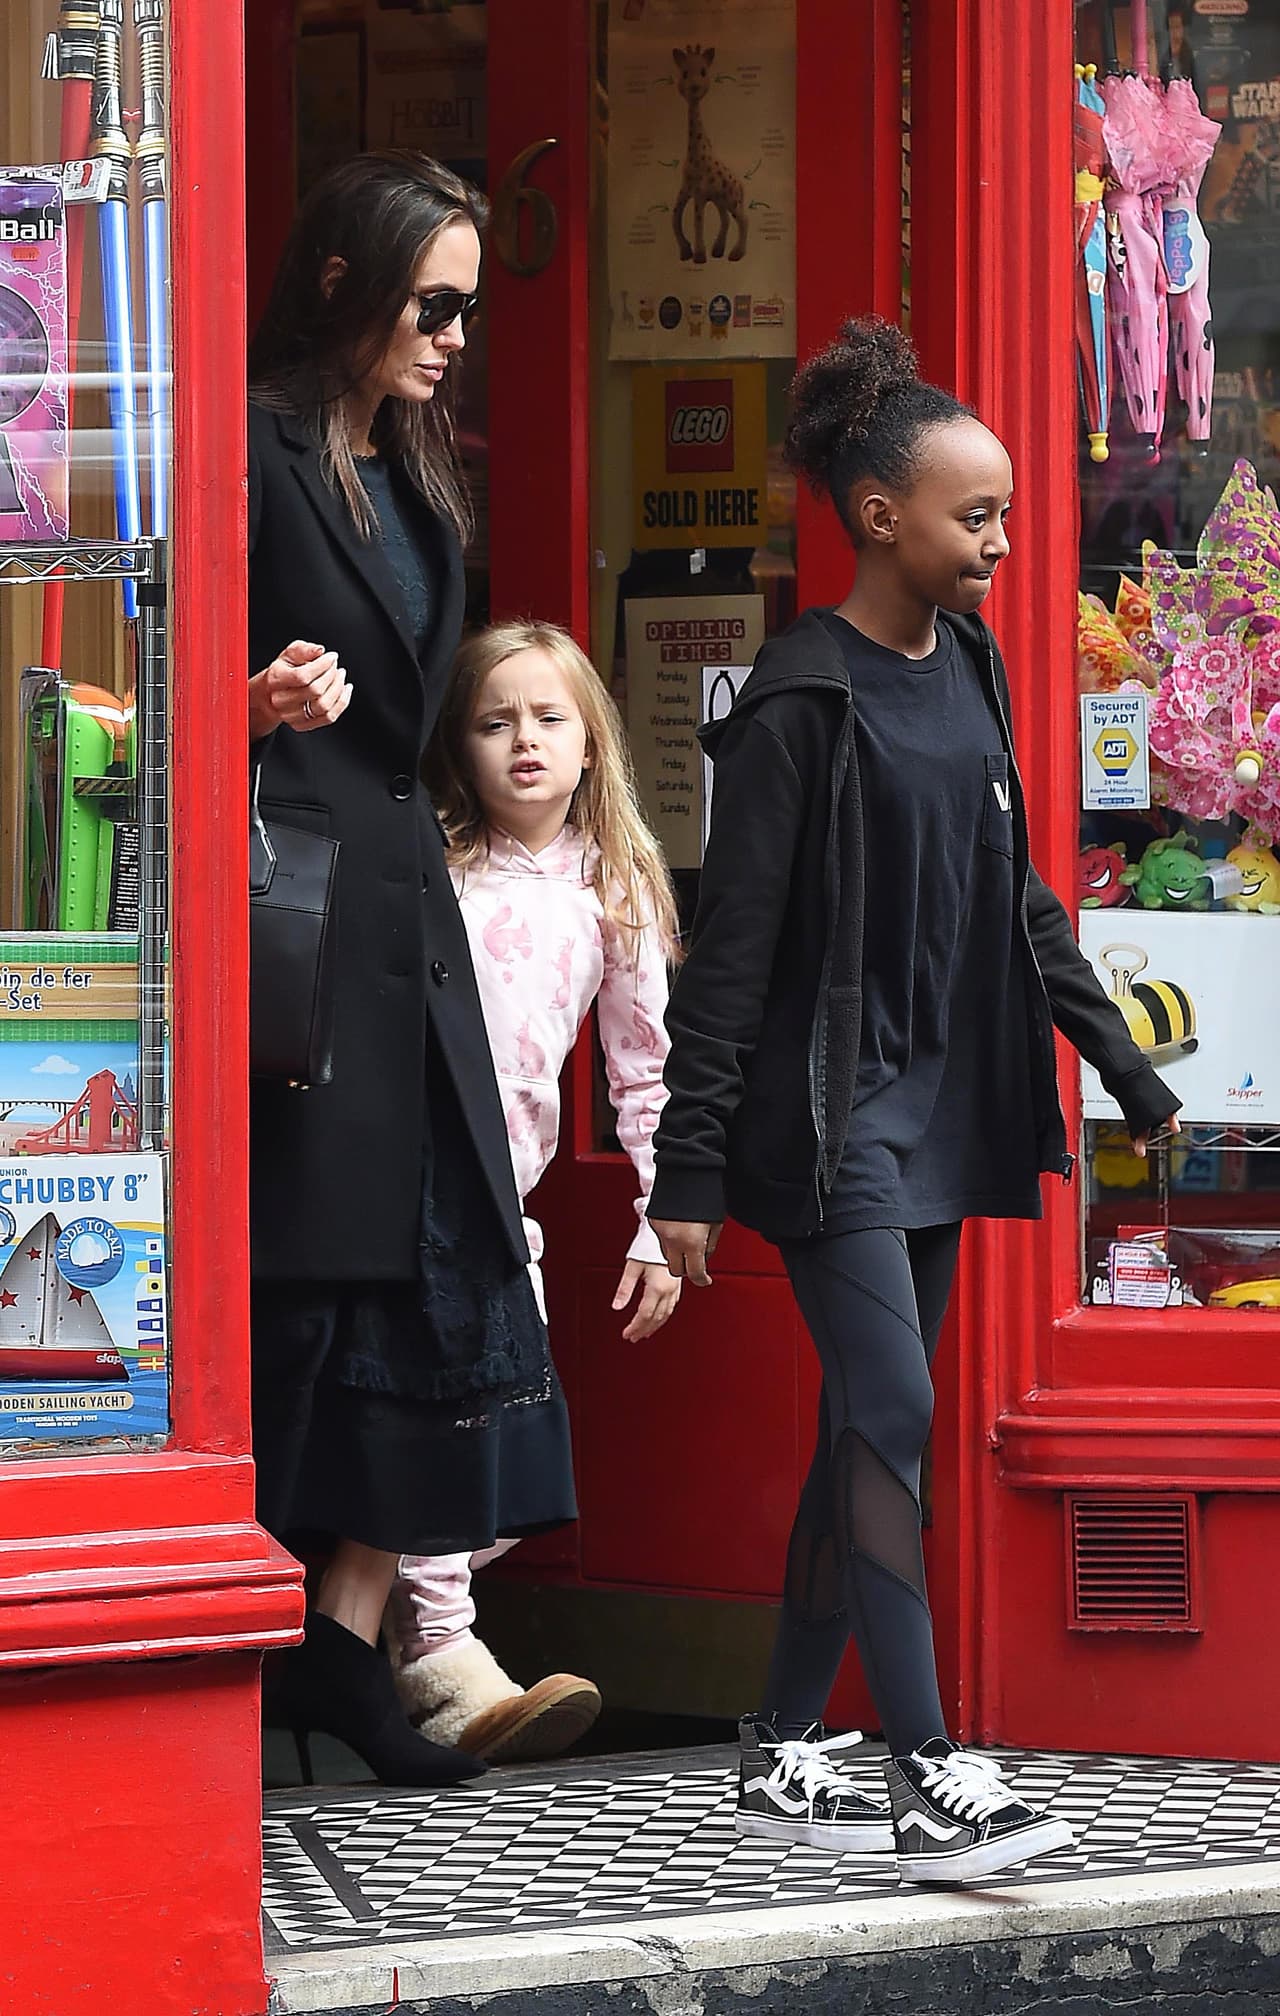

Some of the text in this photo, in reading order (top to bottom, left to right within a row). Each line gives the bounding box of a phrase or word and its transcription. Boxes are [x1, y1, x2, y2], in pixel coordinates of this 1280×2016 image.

[495, 138, 557, 277] 6
[0, 219, 54, 240] Ball
[671, 405, 730, 444] LEGO
[643, 488, 759, 528] SOLD HERE
[646, 621, 745, 640] OPENING
[662, 643, 731, 661] TIMES
[656, 671, 687, 683] Monday
[656, 693, 690, 705] Tuesday
[1090, 701, 1139, 711] Secured
[651, 715, 697, 728] Wednesday
[1094, 713, 1136, 726] by ADT
[656, 737, 693, 749] Thursday
[1104, 742, 1126, 756] ADT
[661, 758, 686, 770] Friday
[655, 780, 693, 793] Saturday
[660, 802, 690, 815] Sunday
[0, 968, 92, 988] in de fer
[1227, 1087, 1263, 1099] Skipper
[0, 1176, 115, 1204] CHUBBY
[57, 1219, 122, 1260] MADE TO SAIL
[0, 1395, 126, 1411] ODEN SAILING YACHT
